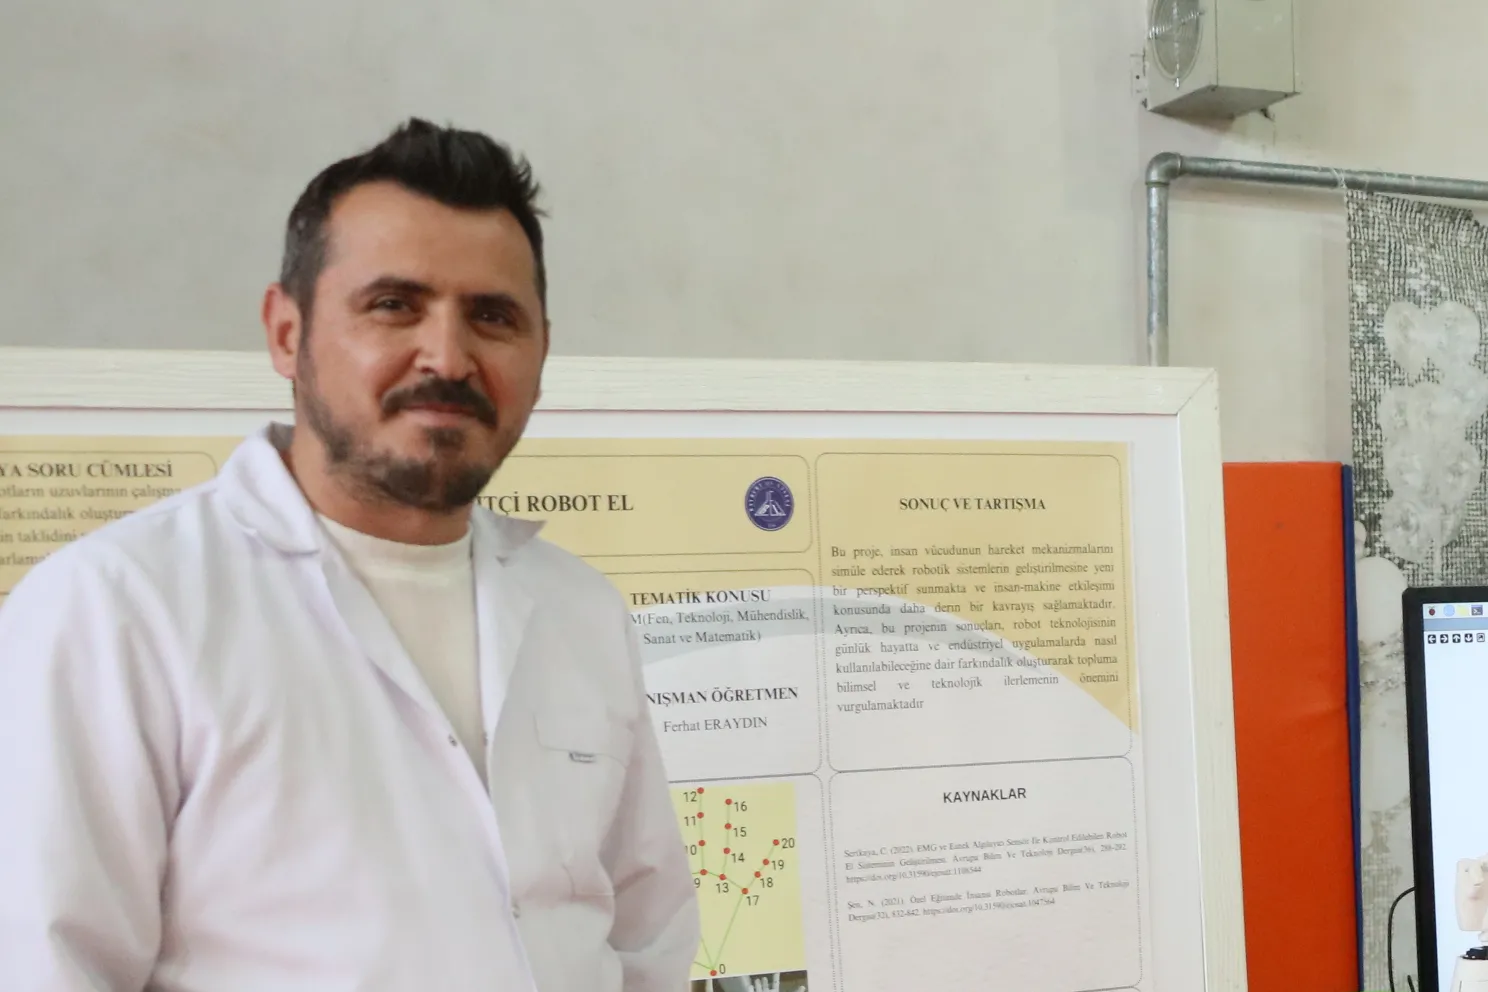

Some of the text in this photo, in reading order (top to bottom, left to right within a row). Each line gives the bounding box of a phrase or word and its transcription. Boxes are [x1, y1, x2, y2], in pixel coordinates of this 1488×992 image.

[27, 462, 81, 478] SORU
[86, 459, 173, 478] CÜMLESİ
[131, 484, 181, 500] çalışm
[526, 494, 602, 513] ROBOT
[607, 494, 634, 512] EL
[899, 497, 1046, 513] SONUÇ VE TARTIŞMA
[0, 506, 76, 520] arkındalık
[831, 545, 846, 558] Bu
[853, 547, 884, 560] proje,
[890, 544, 918, 557] insan
[924, 544, 982, 557] vücudunun
[988, 543, 1025, 556] hareket
[871, 564, 906, 576] ederek
[912, 563, 950, 575] robotik
[956, 562, 1010, 575] sistemlerin
[1015, 561, 1089, 576] geliştirilmesine
[1093, 562, 1115, 574] yeni
[630, 588, 771, 606] TEMATİK KONUSU
[832, 580, 1116, 599] bir perspektif sunmakta ve insan-makine etkileşimi
[676, 611, 734, 625] Teknoloji,
[737, 607, 811, 622] Mühendislik,
[833, 603, 892, 616] konusunda
[900, 602, 926, 614] daha
[934, 601, 961, 613] derin
[969, 601, 984, 612] bir
[992, 600, 1036, 614] kavrayış
[834, 623, 873, 637] Ayrıca,
[881, 622, 895, 634] bu
[904, 621, 948, 636] projenin
[1013, 618, 1042, 630] robot
[1050, 617, 1117, 631] teknolojisinin
[643, 629, 762, 646] Sanat ve Matematik)
[835, 635, 1118, 657] günlük hayatta ve endüstriyel uygulamalarda nasıl
[836, 653, 1119, 674] kullanılabileceğine dair farkındalık oluşturarak topluma
[836, 672, 1120, 694] bilimsel ve teknolojik ilerlemenin önemini
[711, 686, 799, 703] ÖĞRETMEN
[837, 697, 925, 715] vurgulamaktadır
[663, 716, 768, 733] Ferhat ERAYDIN
[683, 791, 697, 803] 12
[942, 787, 1027, 804] KAYNAKLAR
[734, 801, 748, 812] 16
[684, 816, 696, 827] 11
[733, 827, 747, 838] 15
[685, 844, 697, 856] 10
[782, 837, 795, 849] 20
[917, 843, 937, 853] EMG
[732, 853, 745, 863] 14
[772, 859, 785, 870] 19
[694, 877, 701, 888] 9
[716, 882, 729, 894] 13
[760, 877, 774, 888] 18
[747, 895, 759, 906] 17
[718, 963, 726, 975] 0
